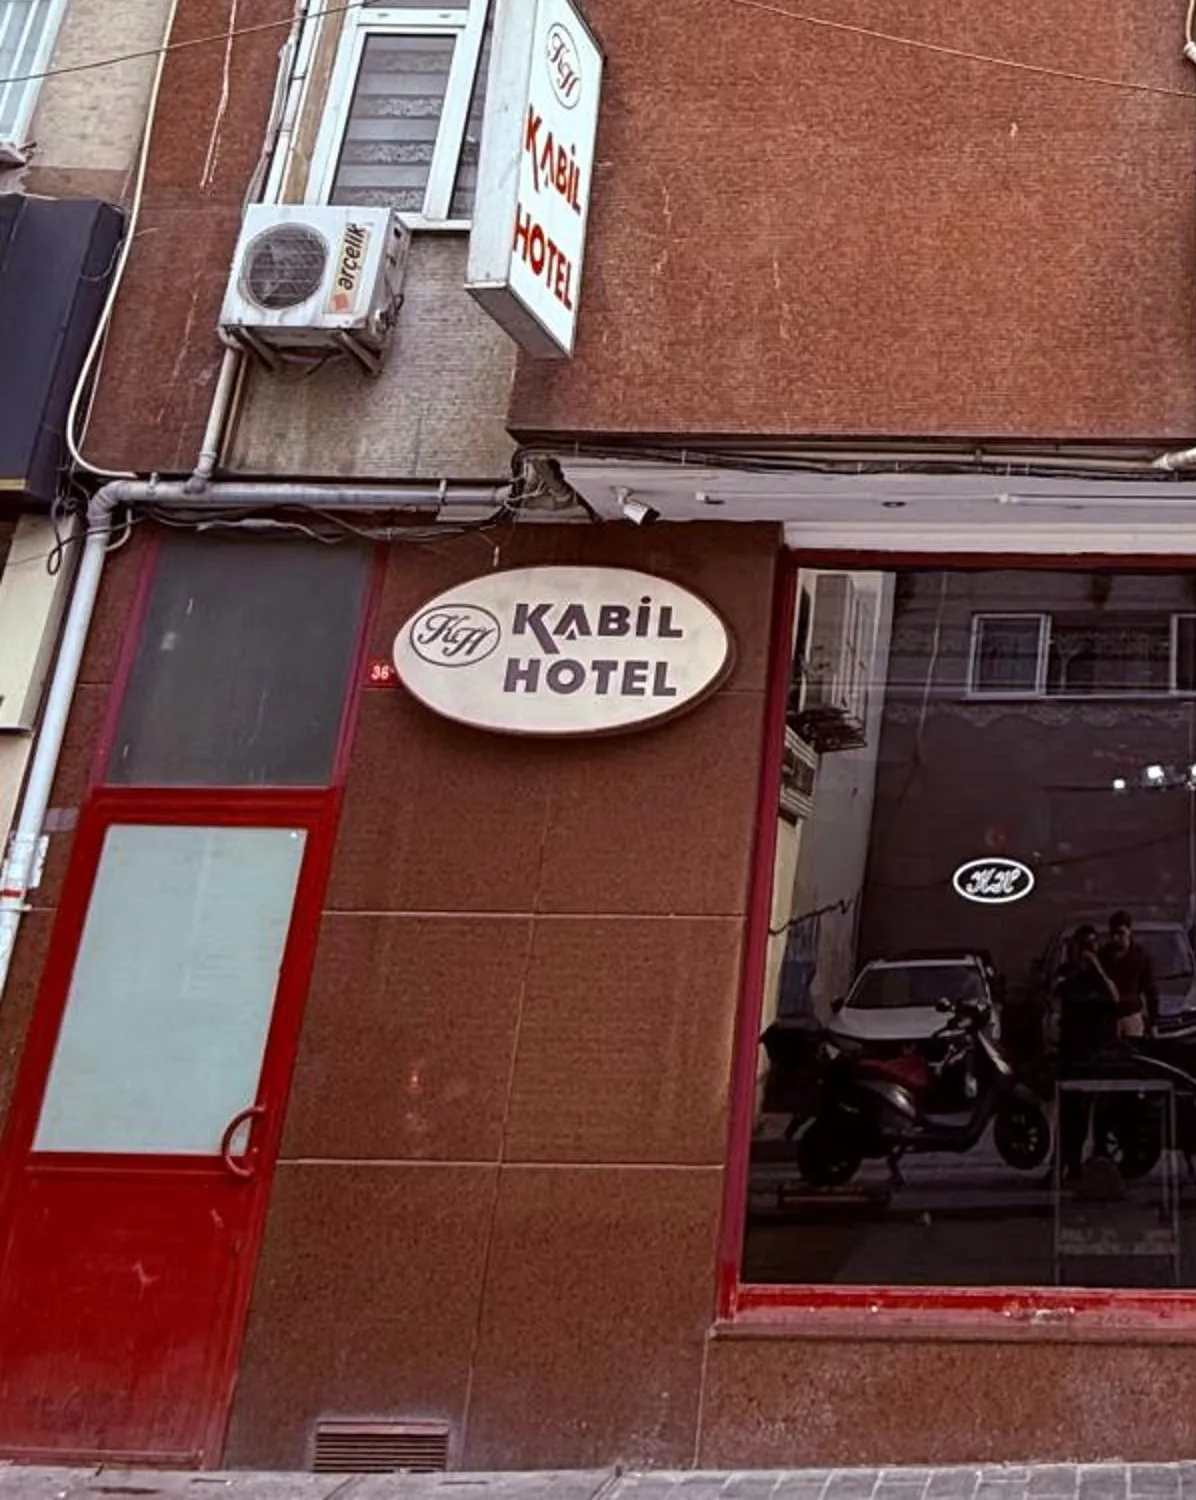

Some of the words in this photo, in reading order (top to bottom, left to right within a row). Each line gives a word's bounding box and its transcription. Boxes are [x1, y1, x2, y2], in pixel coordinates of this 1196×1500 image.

[525, 103, 581, 216] KABİL
[513, 202, 573, 312] HOTEL
[512, 596, 683, 654] KABİL
[503, 658, 677, 697] HOTEL
